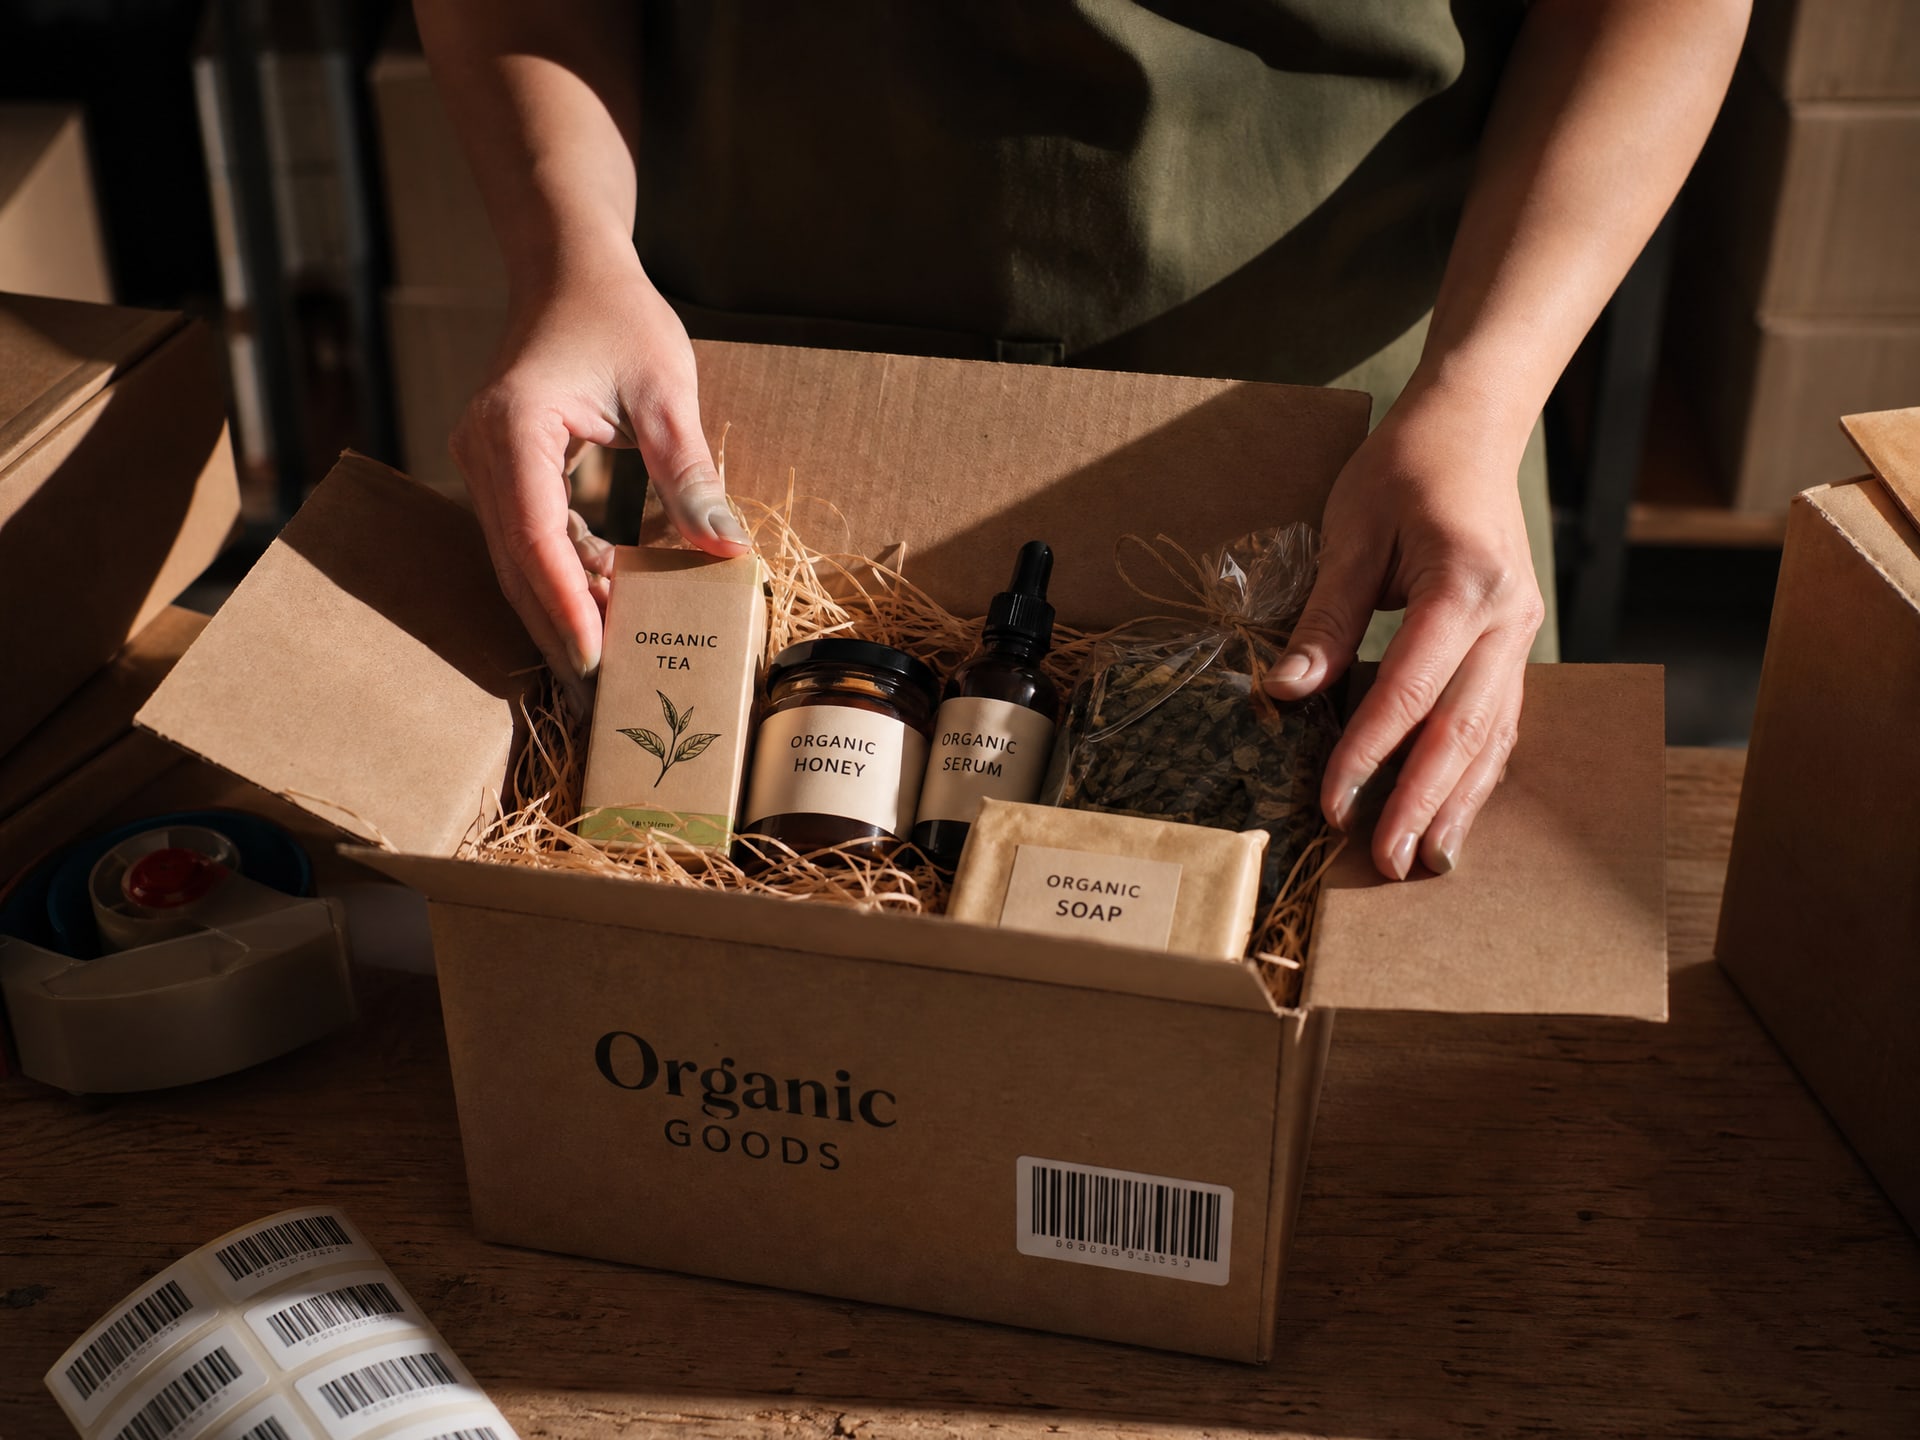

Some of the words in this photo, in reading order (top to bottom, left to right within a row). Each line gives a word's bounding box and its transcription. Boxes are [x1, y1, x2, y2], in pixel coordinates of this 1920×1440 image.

[635, 631, 718, 648] ORGANIC
[656, 655, 690, 671] TEA
[790, 734, 876, 755] ORGANIC
[942, 732, 1017, 755] ORGANIC
[794, 757, 866, 777] HONEY
[943, 757, 1002, 777] SERUM
[1046, 874, 1141, 898] ORGANIC
[1055, 899, 1122, 922] SOAP
[595, 1030, 897, 1128] Organic
[664, 1119, 840, 1170] GOODS
